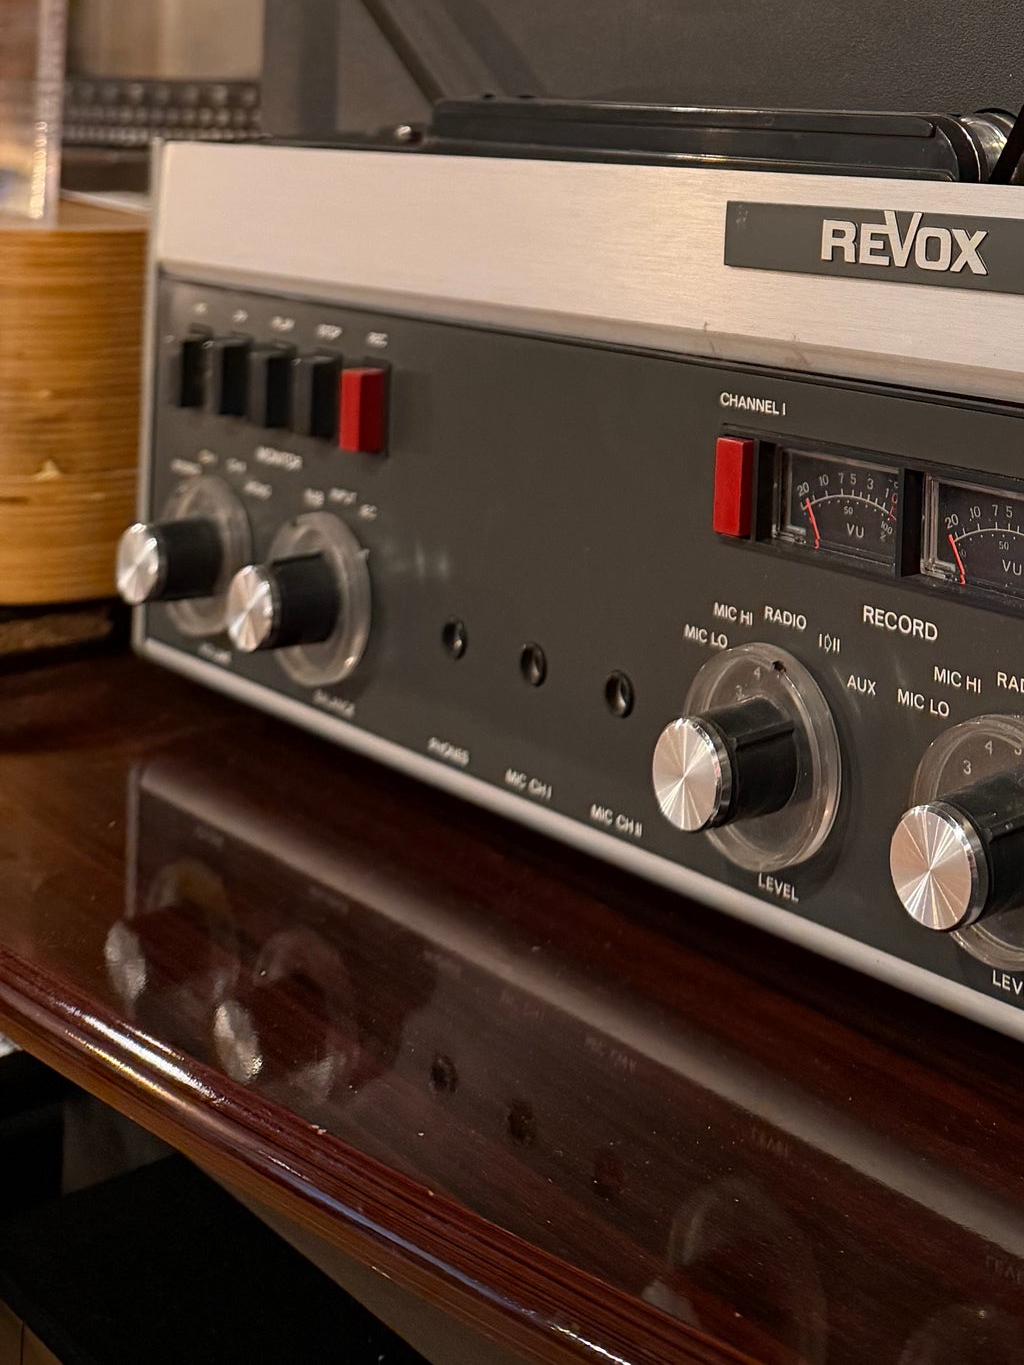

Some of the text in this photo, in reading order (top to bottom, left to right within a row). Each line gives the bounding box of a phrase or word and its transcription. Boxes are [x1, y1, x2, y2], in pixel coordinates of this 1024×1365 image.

[719, 391, 780, 415] CHANNEL
[796, 481, 811, 496] 20
[818, 473, 830, 487] 10
[837, 472, 845, 484] 7
[849, 473, 857, 485] 5
[866, 477, 875, 490] 3
[843, 505, 854, 515] 50
[944, 512, 959, 530] 20
[970, 505, 982, 520] 10
[992, 504, 999, 516] 7
[1005, 505, 1013, 518] 5
[846, 522, 865, 539] VU
[998, 539, 1010, 551] 50
[1001, 559, 1023, 576] VU
[713, 601, 753, 626] MIC HI
[764, 605, 807, 630] RADIO
[863, 604, 938, 642] RECORD
[684, 623, 728, 649] MIC LO
[847, 674, 877, 697] AUX
[934, 665, 982, 694] MIC HI
[897, 688, 950, 718] MIC LO
[984, 739, 993, 756] 4
[504, 768, 527, 788] MIC
[962, 758, 972, 776] 3
[589, 803, 614, 826] MIC
[758, 872, 799, 903] LEVEL
